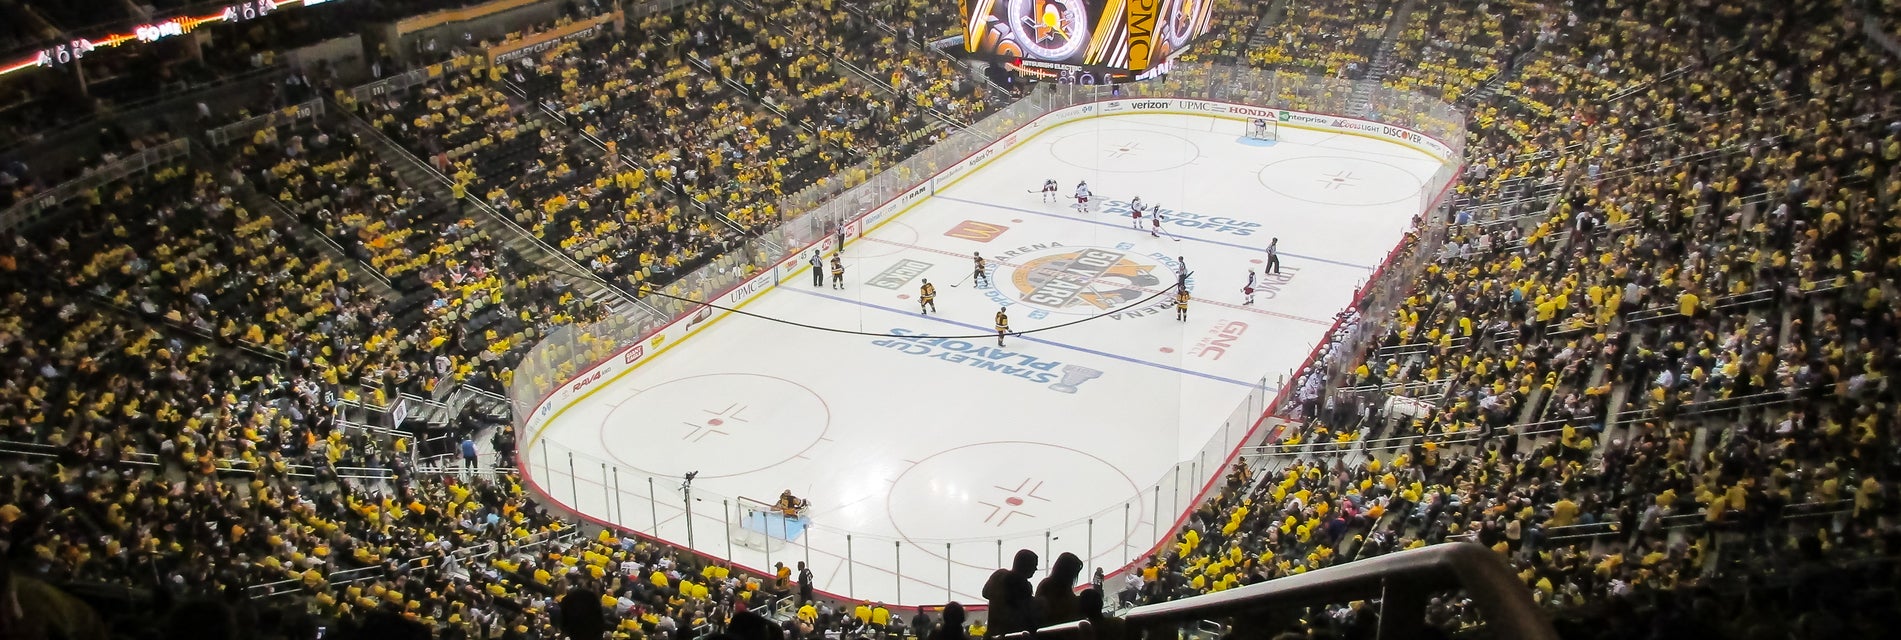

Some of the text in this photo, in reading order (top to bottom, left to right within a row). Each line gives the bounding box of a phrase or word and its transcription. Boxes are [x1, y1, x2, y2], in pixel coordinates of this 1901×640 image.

[1131, 100, 1169, 110] verizon
[1179, 101, 1210, 112] UPMC
[1229, 106, 1276, 119] HONDA
[1383, 126, 1422, 145] DISCOVER
[908, 186, 926, 200] RAM
[1208, 217, 1262, 228] CUP
[994, 241, 1064, 261] ARENA
[730, 276, 759, 304] UPMC
[889, 327, 1062, 371] PLAYOFFS
[1197, 321, 1249, 361] GNC
[871, 339, 1060, 384] STANLEY CUP
[572, 371, 602, 393] RAV4
